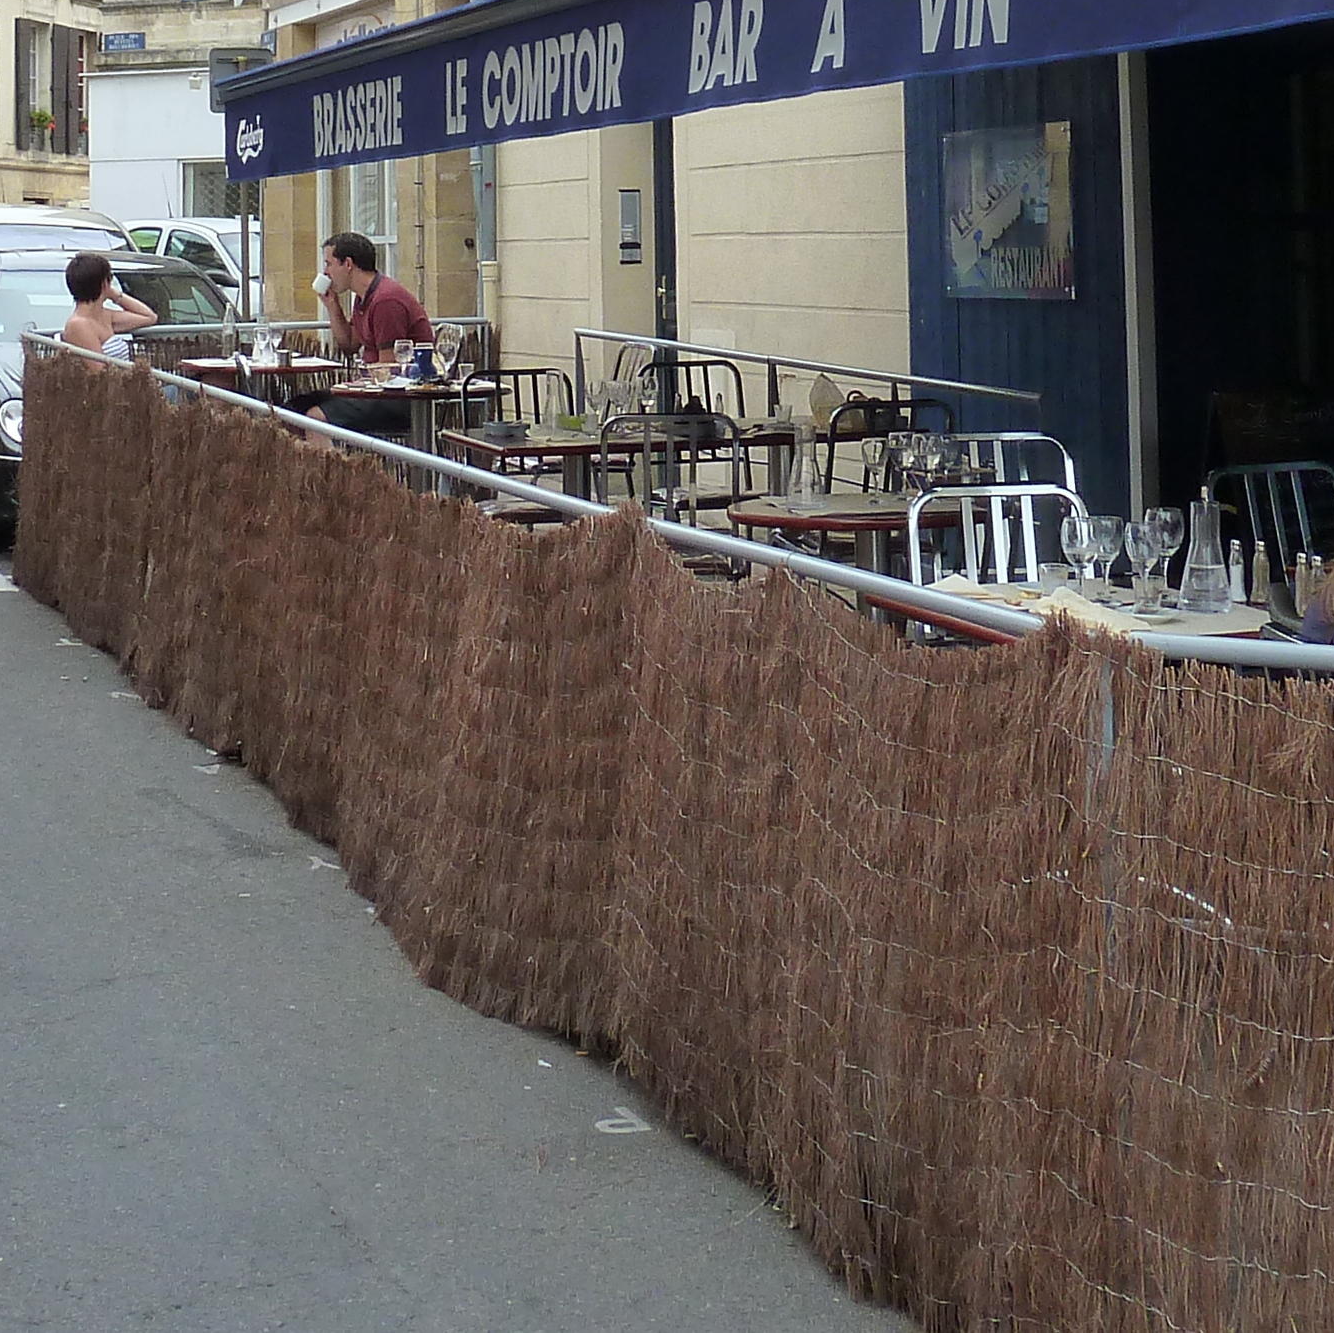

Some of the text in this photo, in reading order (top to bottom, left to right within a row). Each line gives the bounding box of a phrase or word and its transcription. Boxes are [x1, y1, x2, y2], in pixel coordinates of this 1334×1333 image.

[313, 75, 403, 158] BRASSERIE
[445, 58, 467, 135] LE
[482, 22, 624, 129] COMPTOIR
[991, 246, 1067, 288] RESTAURANT
